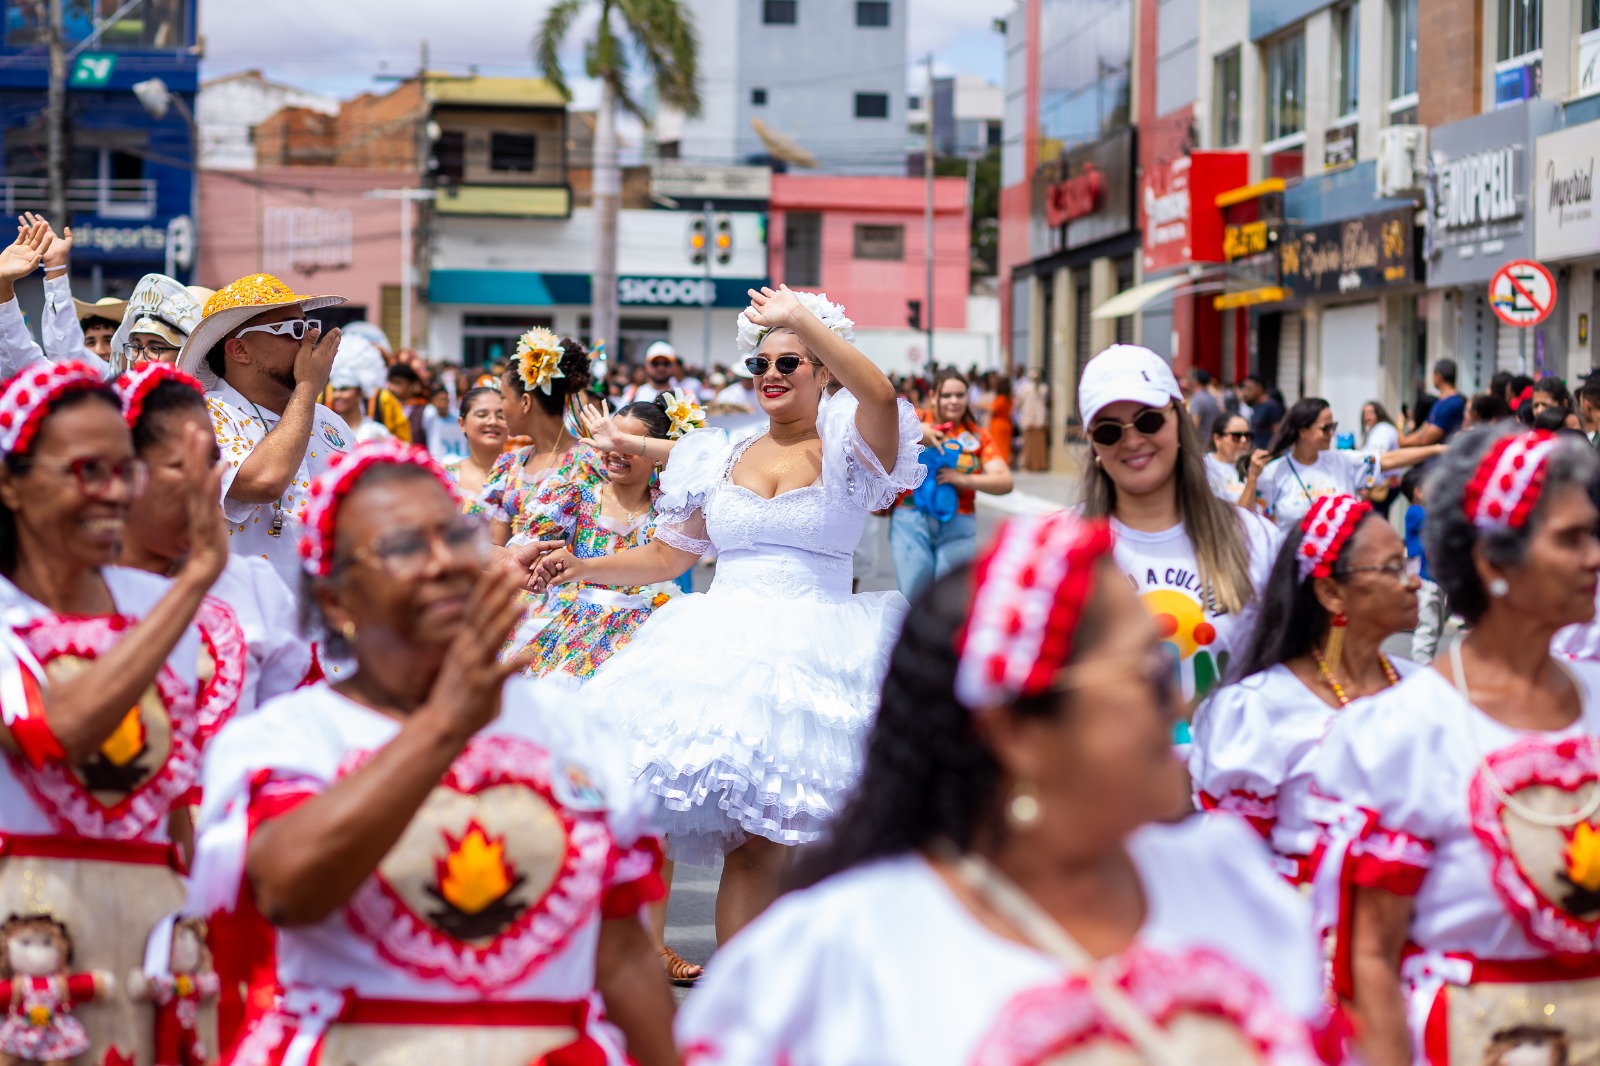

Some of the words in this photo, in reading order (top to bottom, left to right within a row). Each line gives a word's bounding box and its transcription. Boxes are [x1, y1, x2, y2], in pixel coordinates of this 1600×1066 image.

[1546, 157, 1594, 229] Imperial
[620, 278, 716, 304] SICOOB
[1147, 568, 1158, 585] A
